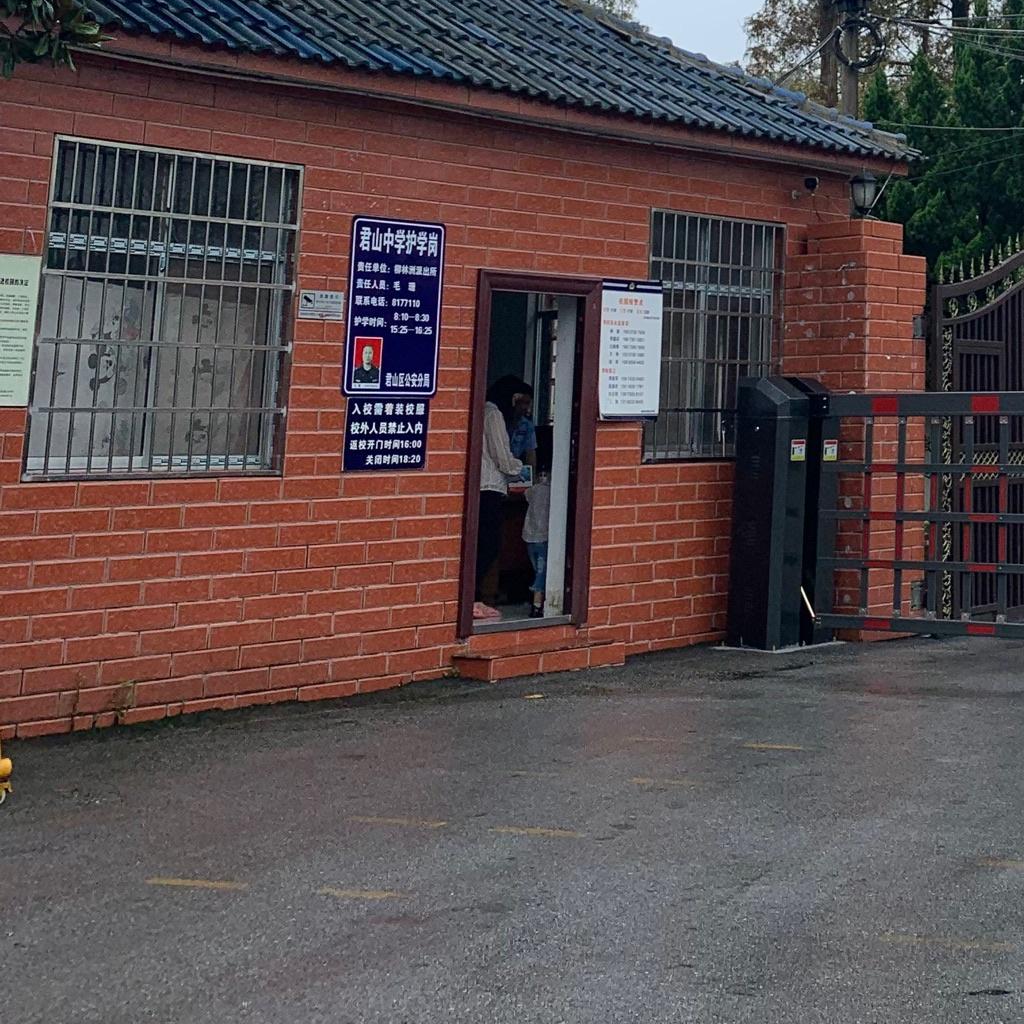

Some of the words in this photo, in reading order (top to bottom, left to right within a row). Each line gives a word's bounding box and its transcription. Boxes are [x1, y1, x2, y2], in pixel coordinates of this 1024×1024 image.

[359, 226, 438, 257] 君山中学护学岗
[385, 372, 430, 388] 君山区公安分局
[351, 402, 425, 416] 入校需着装校服
[350, 421, 423, 435] 校外人员禁止入内
[365, 454, 421, 466] 关闭时间18:20
